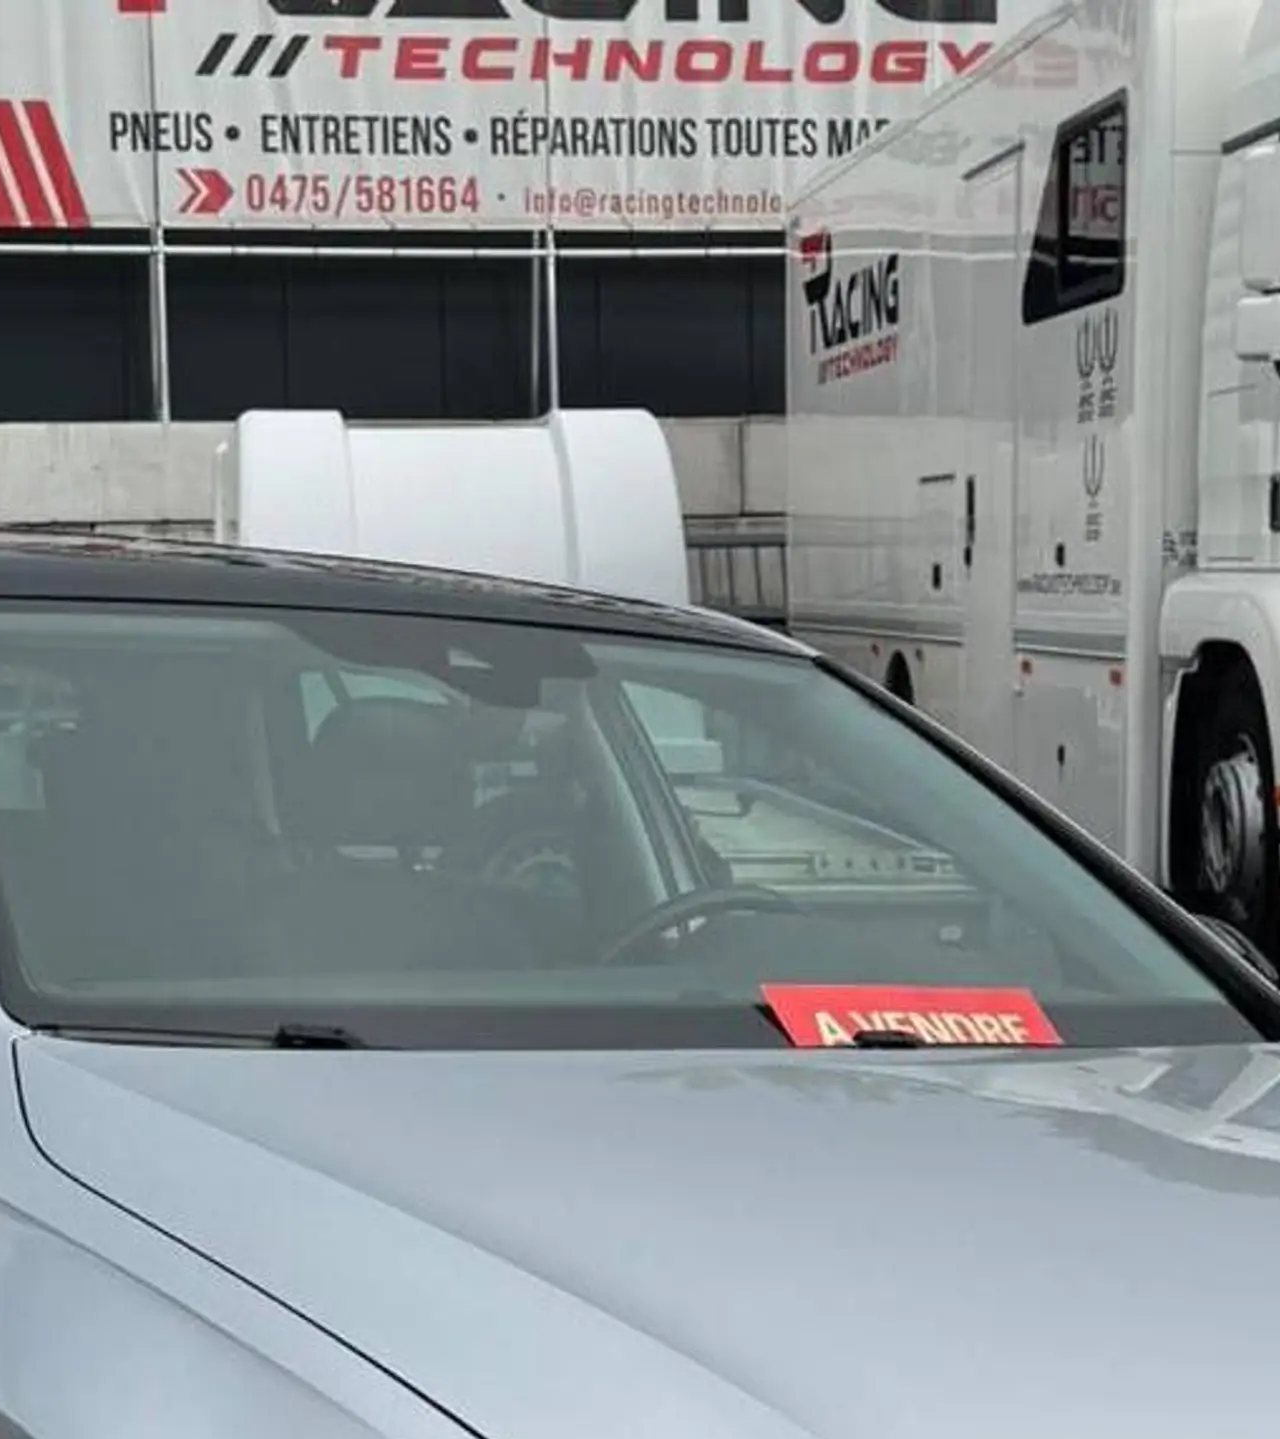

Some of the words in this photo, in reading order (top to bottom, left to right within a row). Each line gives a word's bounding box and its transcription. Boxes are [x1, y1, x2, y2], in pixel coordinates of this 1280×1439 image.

[323, 36, 994, 83] TECHNOLOGY
[109, 112, 214, 152] PNEUS
[261, 114, 452, 156] ENTRETIENS
[490, 109, 697, 157] RÉPARATIONS
[705, 117, 818, 157] TOUTES
[246, 173, 479, 216] 0475/581664
[815, 1011, 845, 1045] A
